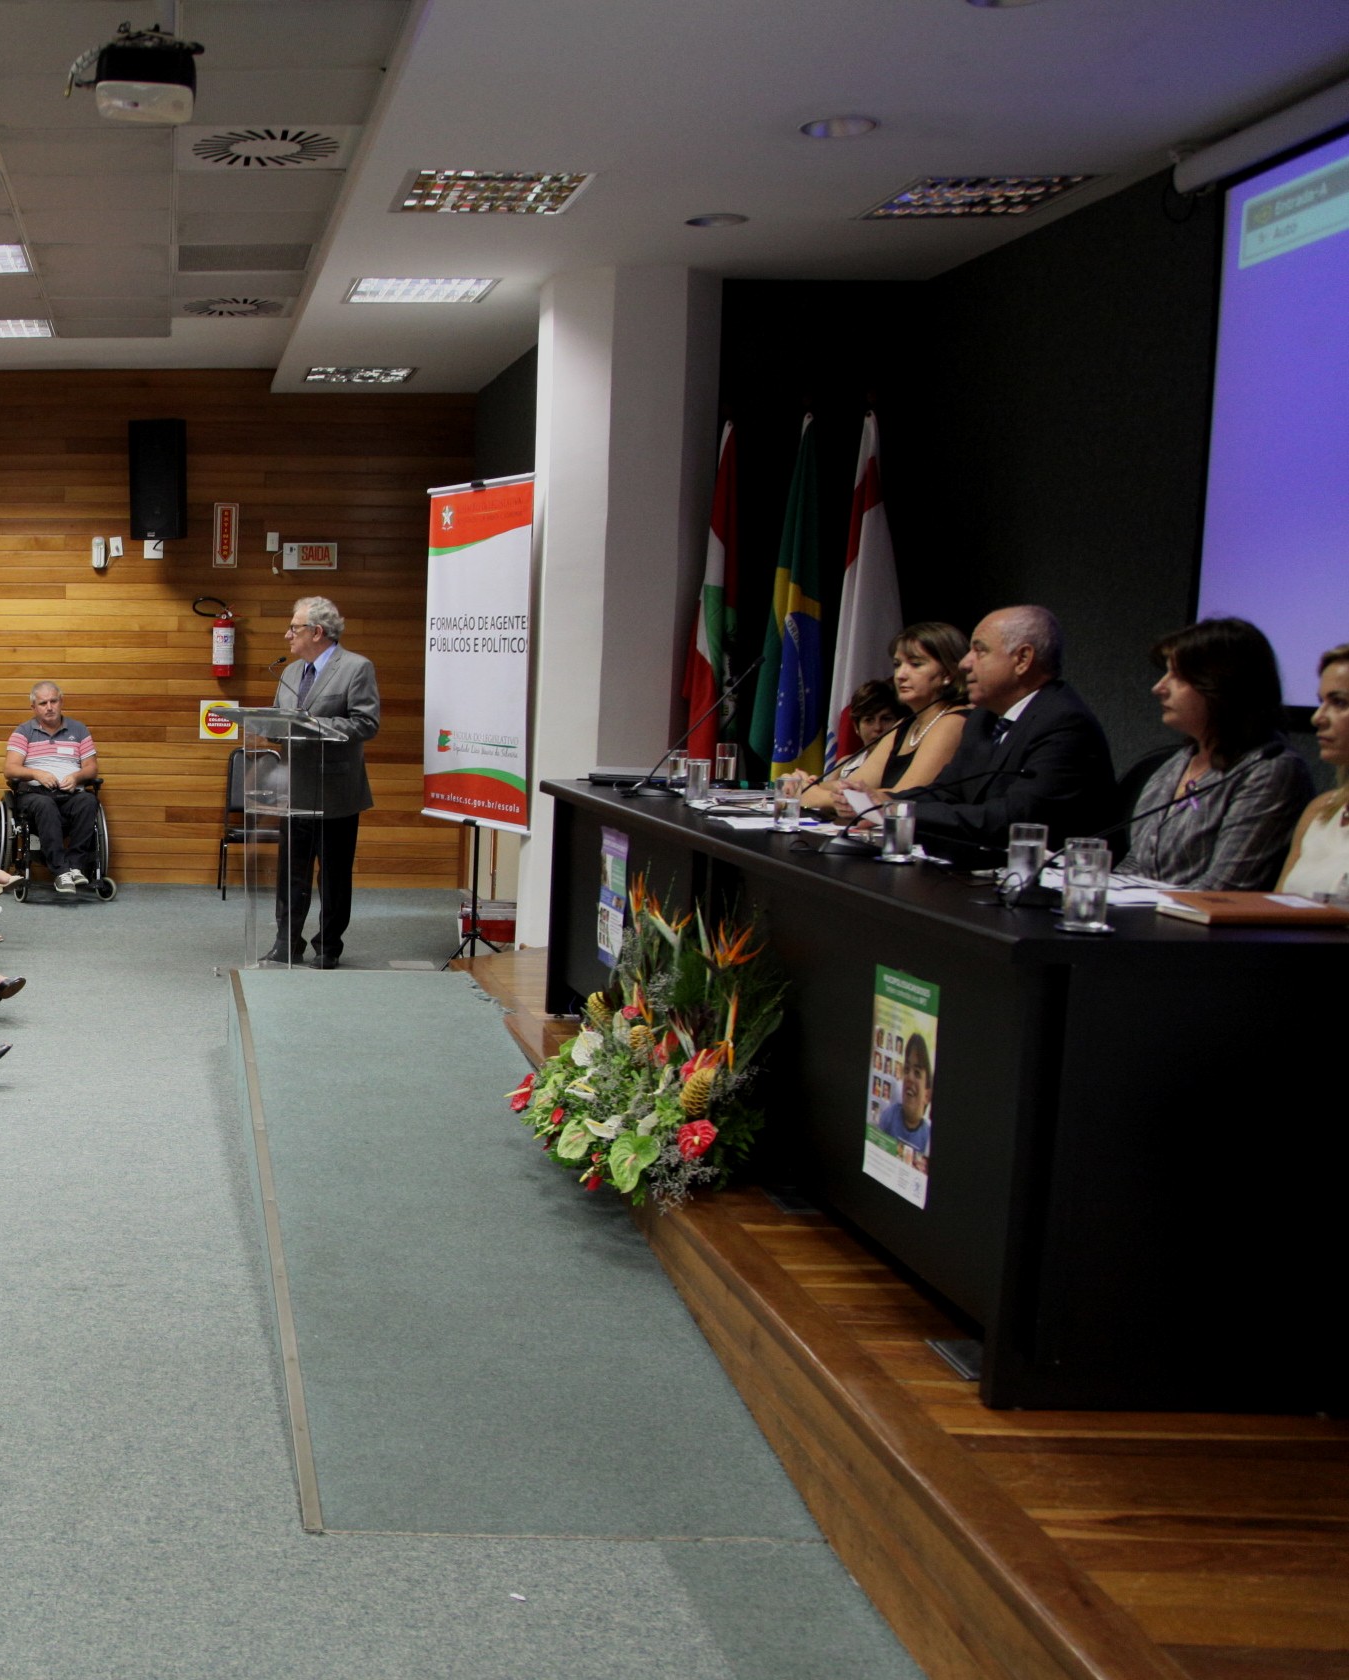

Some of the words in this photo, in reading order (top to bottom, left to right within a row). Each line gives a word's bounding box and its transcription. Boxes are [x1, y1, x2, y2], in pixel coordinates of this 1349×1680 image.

[430, 613, 475, 634] FORMAÇÃO
[478, 616, 488, 630] DE
[429, 634, 471, 653] PÚBLICOS
[473, 637, 479, 652] E
[430, 792, 520, 813] www.alesc.sc.gov.br/escola
